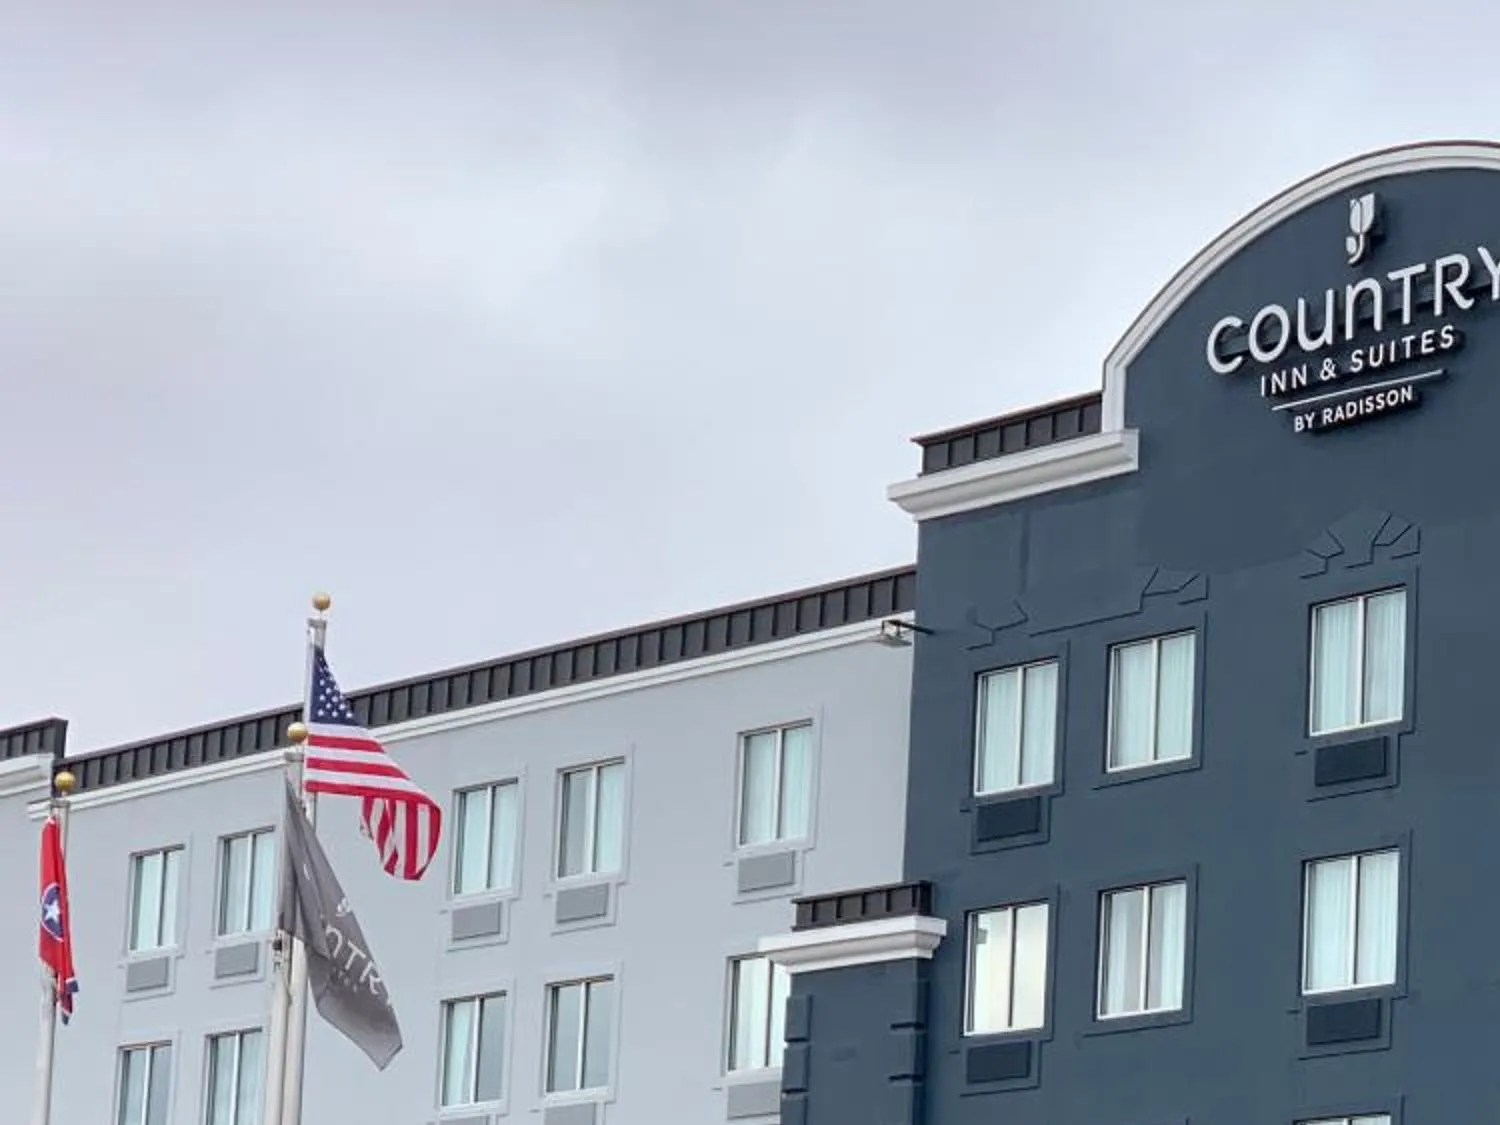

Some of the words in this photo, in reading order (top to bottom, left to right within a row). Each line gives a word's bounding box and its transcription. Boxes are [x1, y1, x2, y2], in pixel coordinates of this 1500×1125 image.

[1260, 363, 1309, 398] INN
[1319, 357, 1338, 382] &
[1350, 324, 1456, 373] SUITES
[1294, 409, 1315, 433] BY
[1322, 386, 1414, 424] RADISSON
